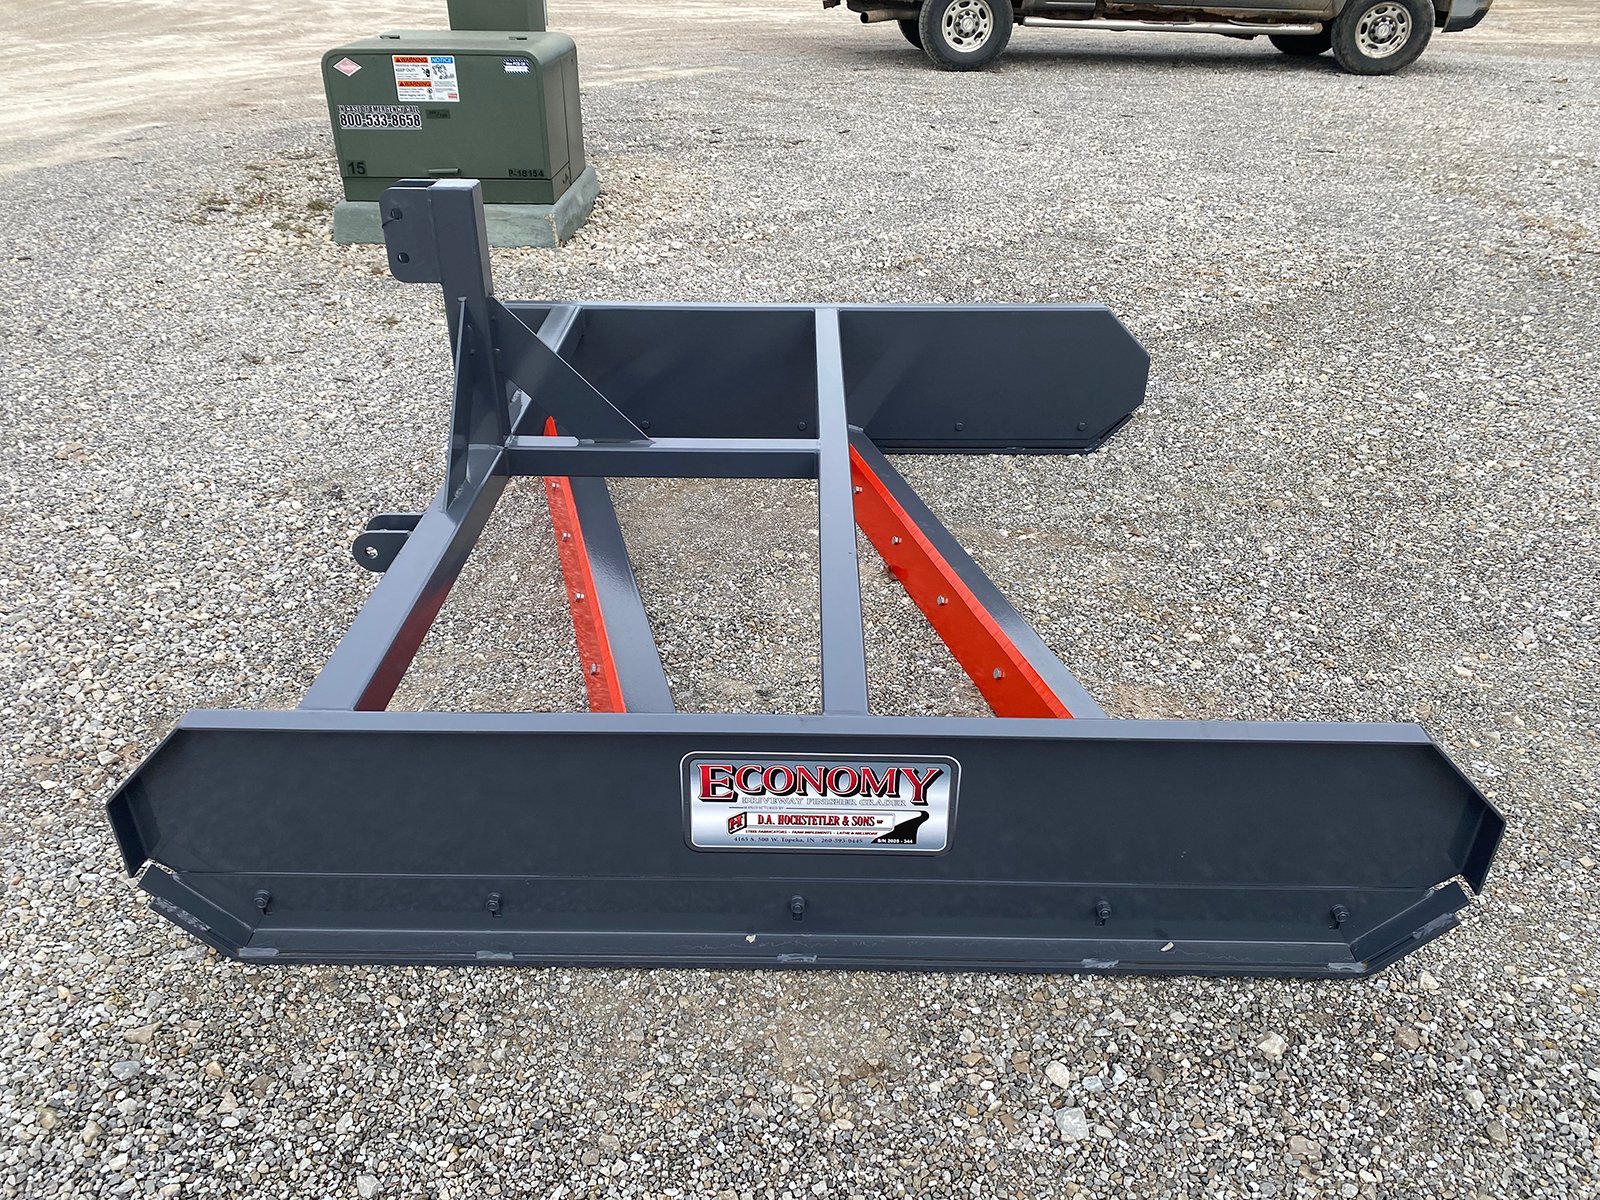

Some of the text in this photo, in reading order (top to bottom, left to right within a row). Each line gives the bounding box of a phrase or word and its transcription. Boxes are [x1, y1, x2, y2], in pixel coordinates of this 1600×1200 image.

[338, 105, 420, 113] IN CASE OF EMERGENCY CALL
[340, 113, 421, 127] 800-533-8658
[348, 161, 366, 175] 15
[698, 764, 944, 806] ECONOMY
[742, 797, 907, 806] DRIVEWAY FINISHER GRADER
[757, 814, 775, 825] D.A.
[778, 814, 841, 826] HOCHSTETLER
[842, 815, 849, 826] &
[851, 815, 875, 826] SONS
